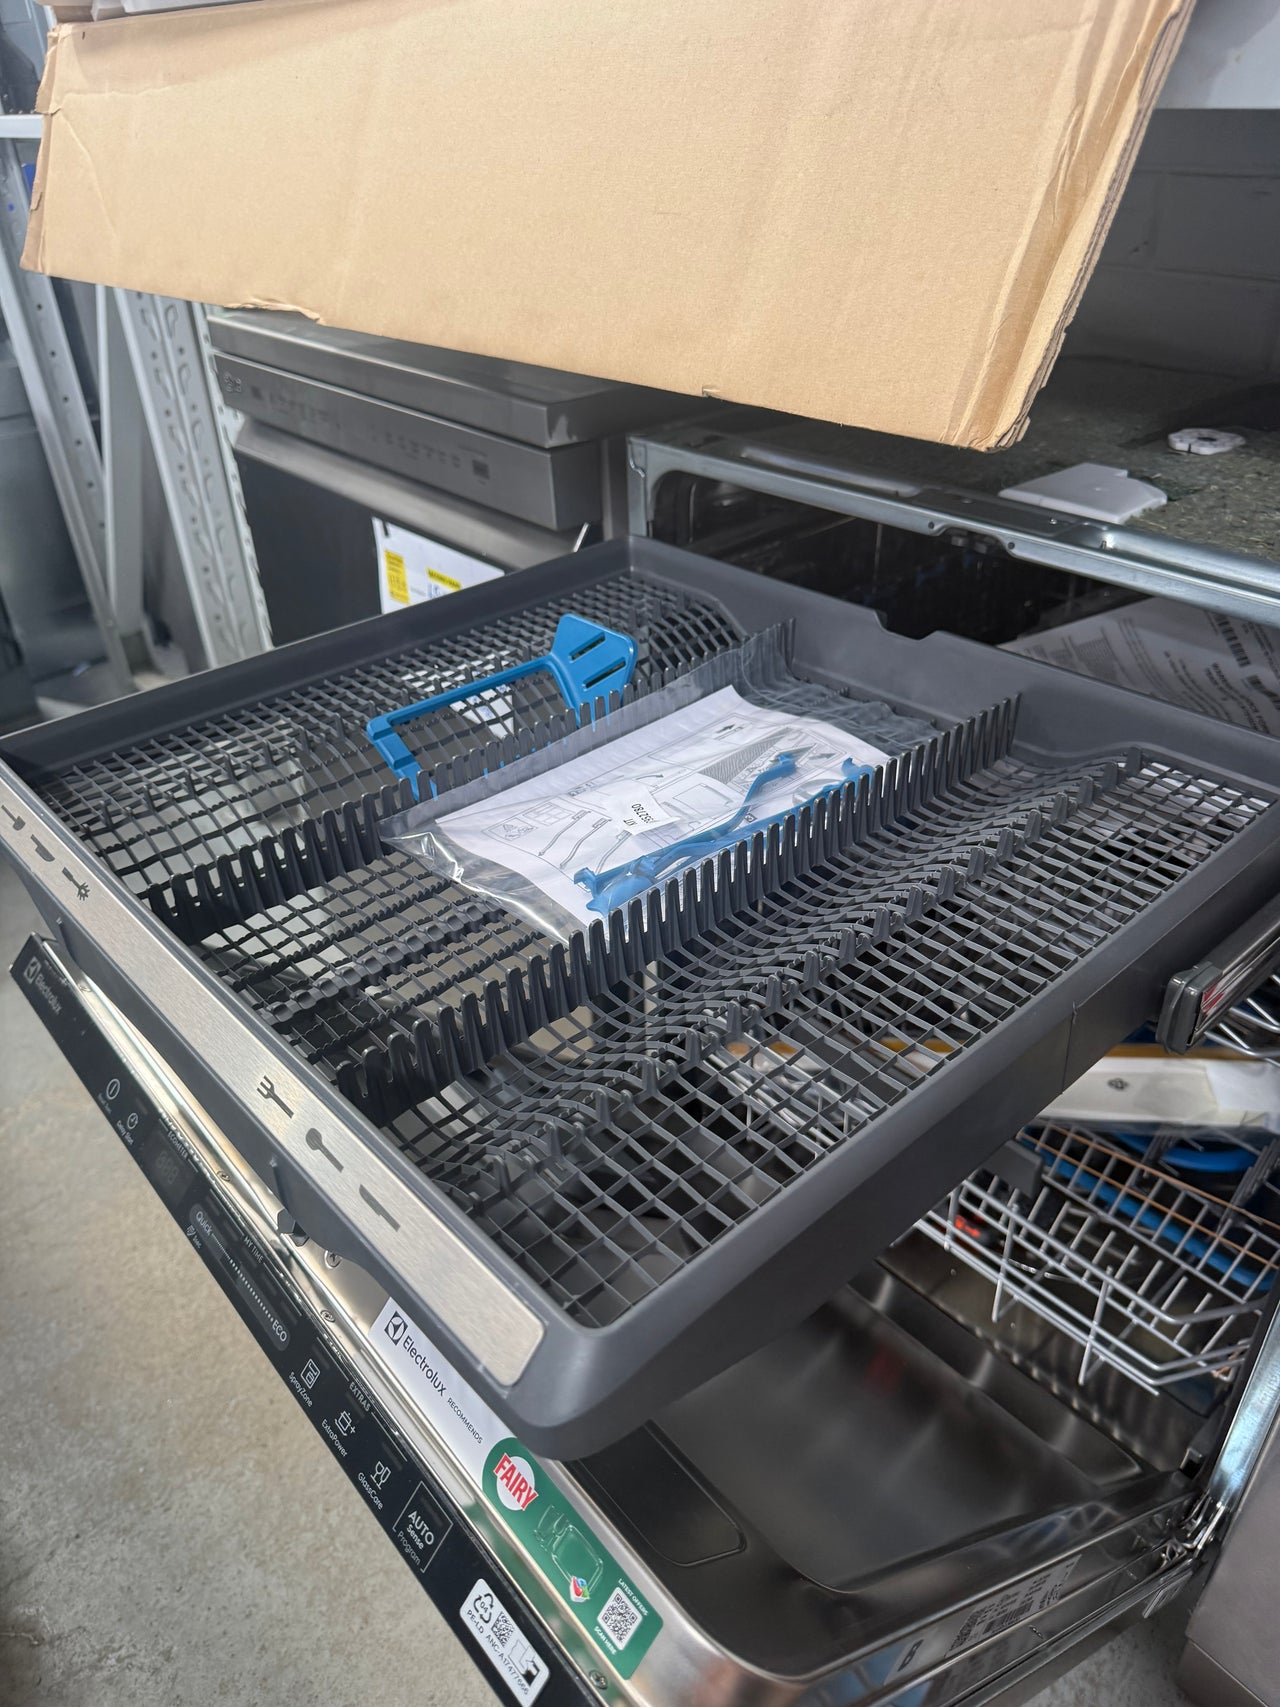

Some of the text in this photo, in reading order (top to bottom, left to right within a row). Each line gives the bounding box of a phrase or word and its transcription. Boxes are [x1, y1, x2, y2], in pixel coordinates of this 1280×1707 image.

[195, 1210, 212, 1236] Quick
[243, 1235, 264, 1264] MY TIME
[272, 1319, 288, 1342] ECO
[289, 1371, 313, 1408] SprayZone
[349, 1381, 371, 1412] EXTRAS
[403, 1335, 483, 1444] Electrolux RECOMMENDS
[321, 1418, 348, 1457] ExtraPower
[357, 1472, 384, 1510] GlassCare
[493, 1452, 539, 1511] FAIRY
[408, 1510, 435, 1545] AUTO
[397, 1530, 421, 1566] Program
[479, 1600, 489, 1614] 04
[618, 1578, 649, 1616] LATEST OFFERS
[466, 1609, 484, 1634] PE-LD
[594, 1625, 617, 1656] SCAN HERE
